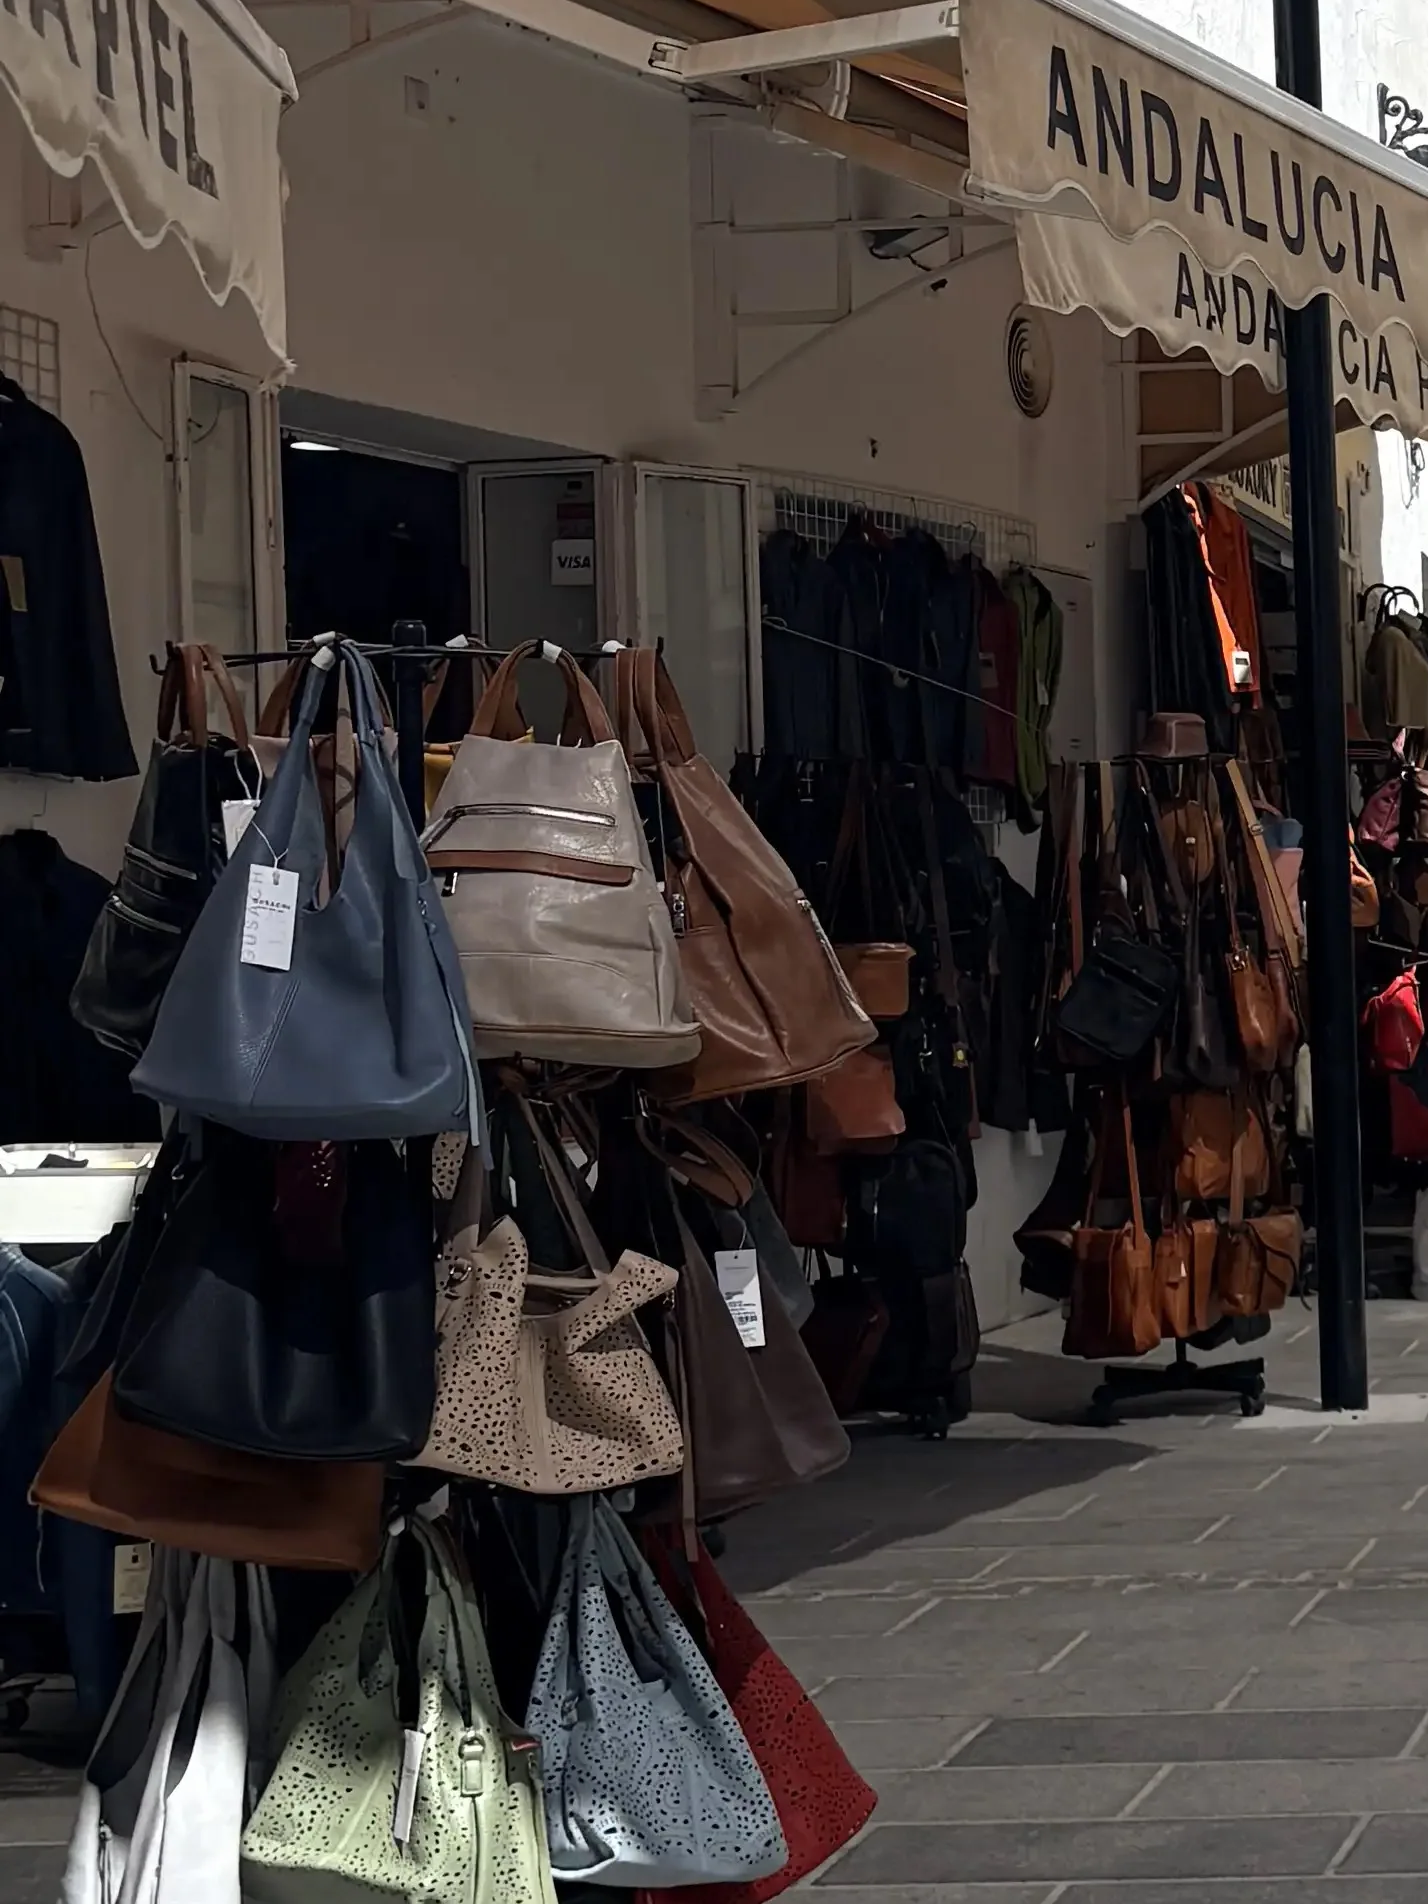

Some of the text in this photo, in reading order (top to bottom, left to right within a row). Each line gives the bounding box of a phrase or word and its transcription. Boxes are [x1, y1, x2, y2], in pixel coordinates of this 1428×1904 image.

[1046, 45, 1406, 303] ANDALUCIA
[1174, 252, 1398, 401] ANDACIA
[556, 555, 592, 570] VISA
